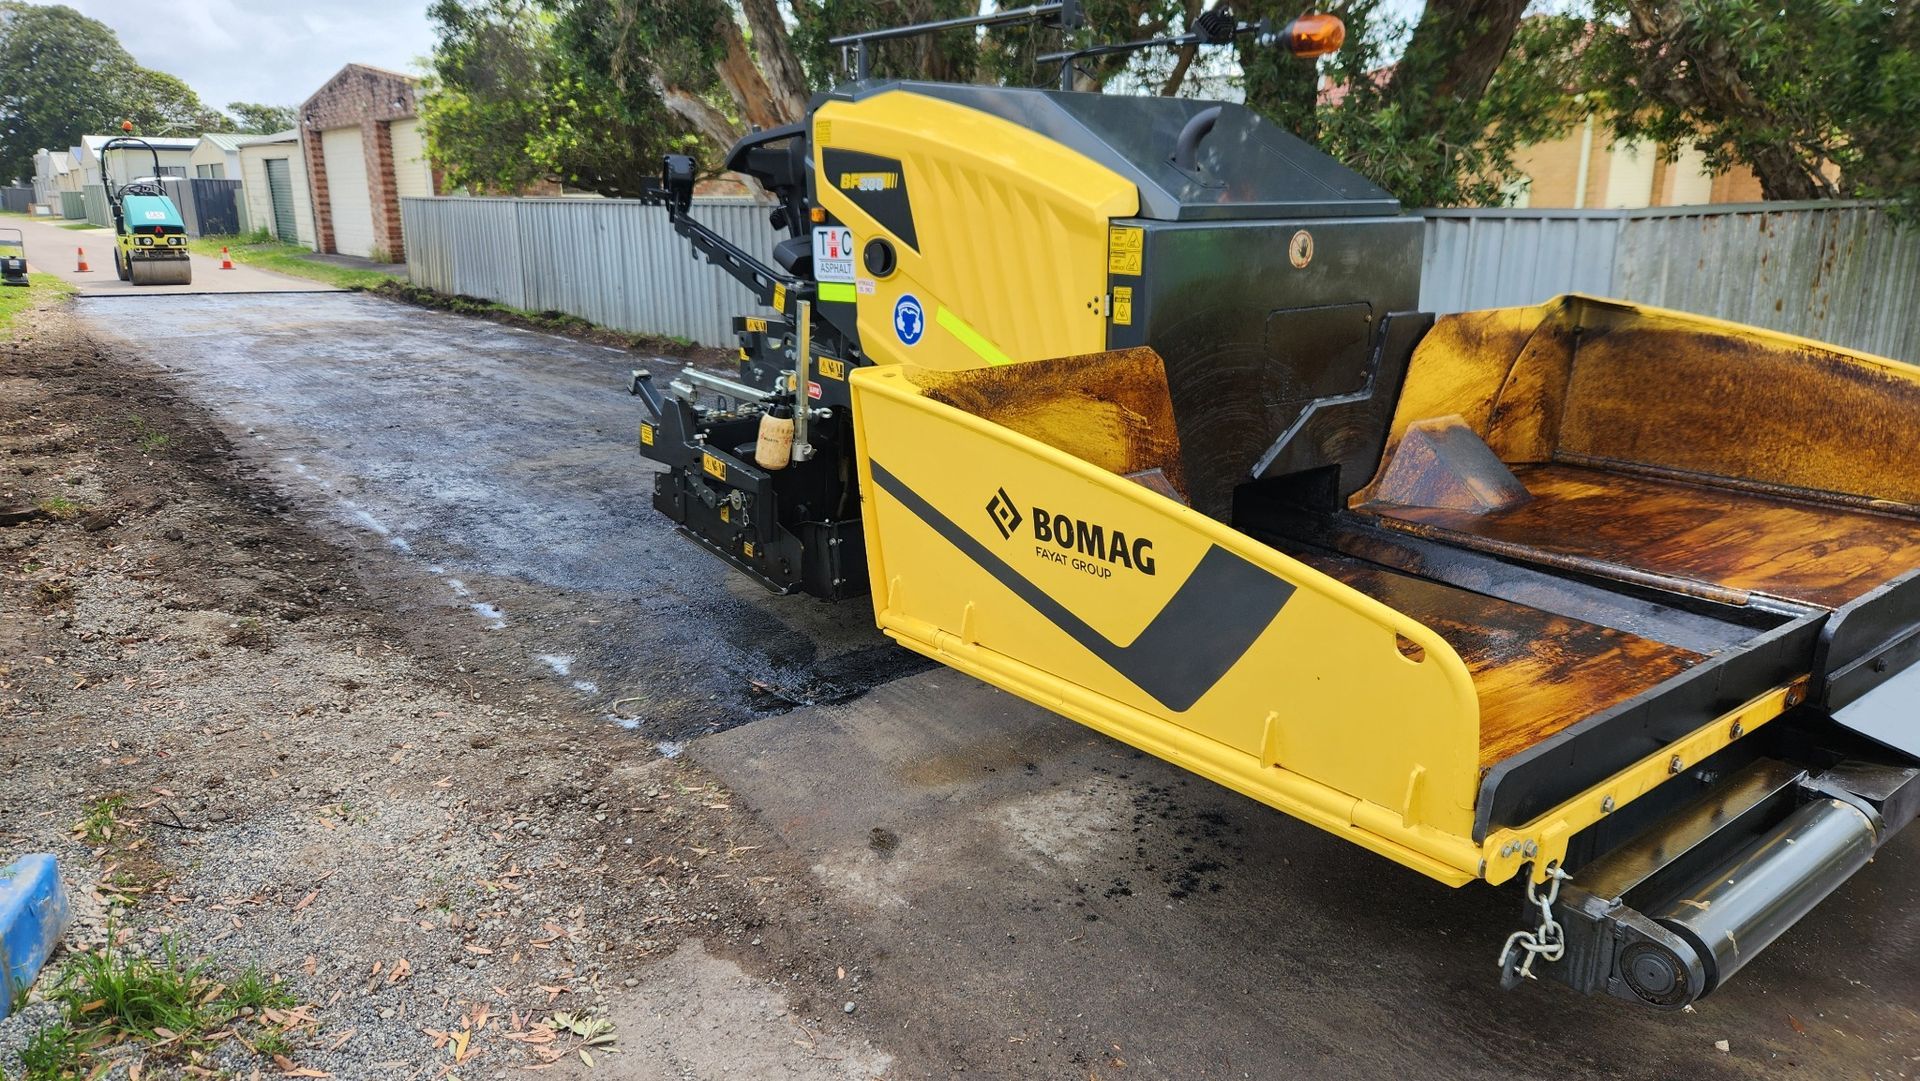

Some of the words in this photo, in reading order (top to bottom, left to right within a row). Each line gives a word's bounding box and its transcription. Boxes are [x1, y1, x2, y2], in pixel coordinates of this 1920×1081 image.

[820, 263, 852, 274] ASPHALT
[1032, 507, 1156, 576] BOMAG
[1035, 546, 1068, 566] FAYAT
[1071, 558, 1112, 579] GROUP
